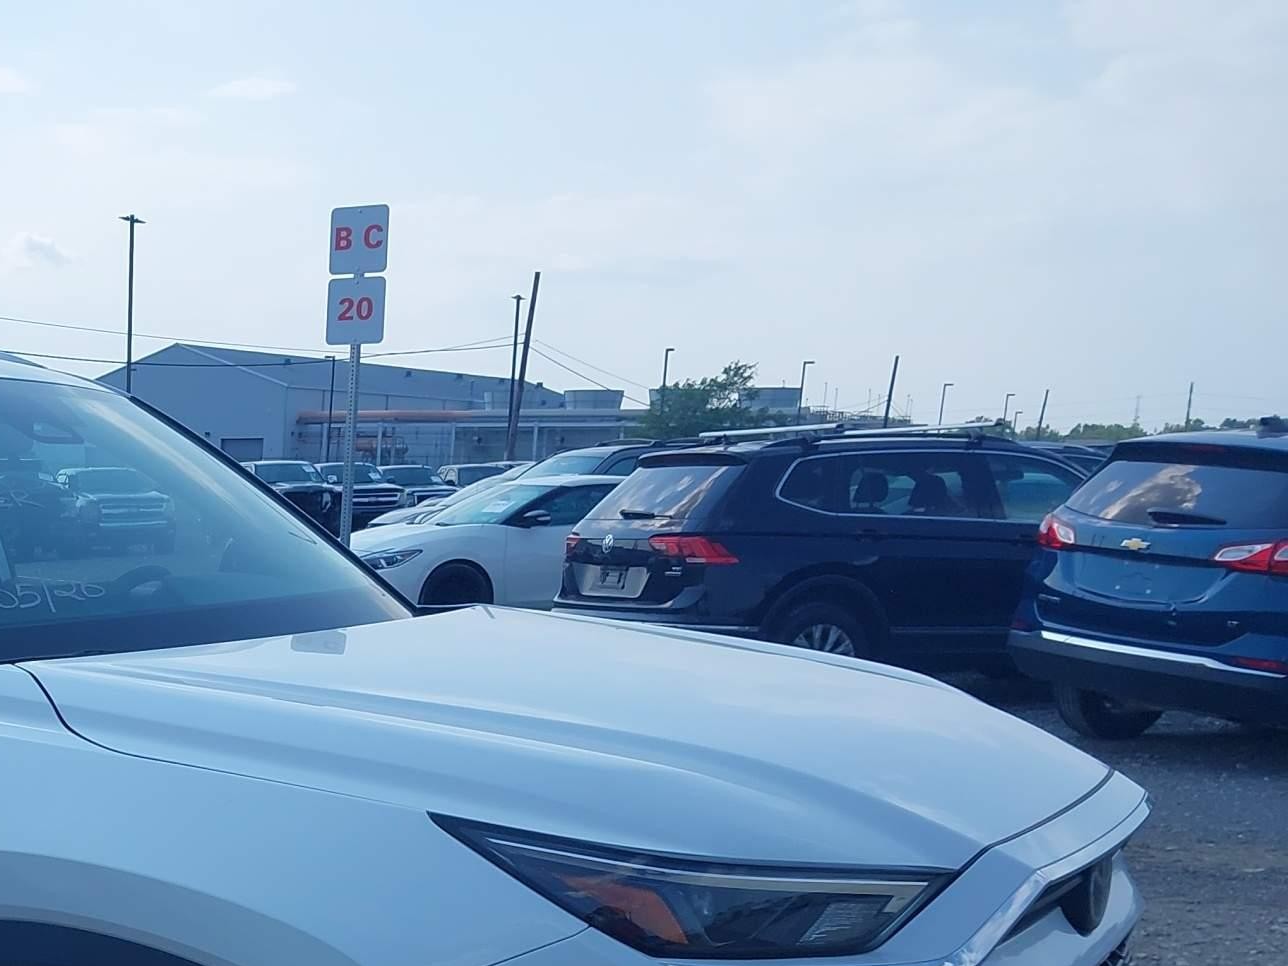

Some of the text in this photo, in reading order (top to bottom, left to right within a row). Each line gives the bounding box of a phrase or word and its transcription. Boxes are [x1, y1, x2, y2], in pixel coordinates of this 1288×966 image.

[334, 224, 384, 252] B C
[337, 296, 374, 321] 20
